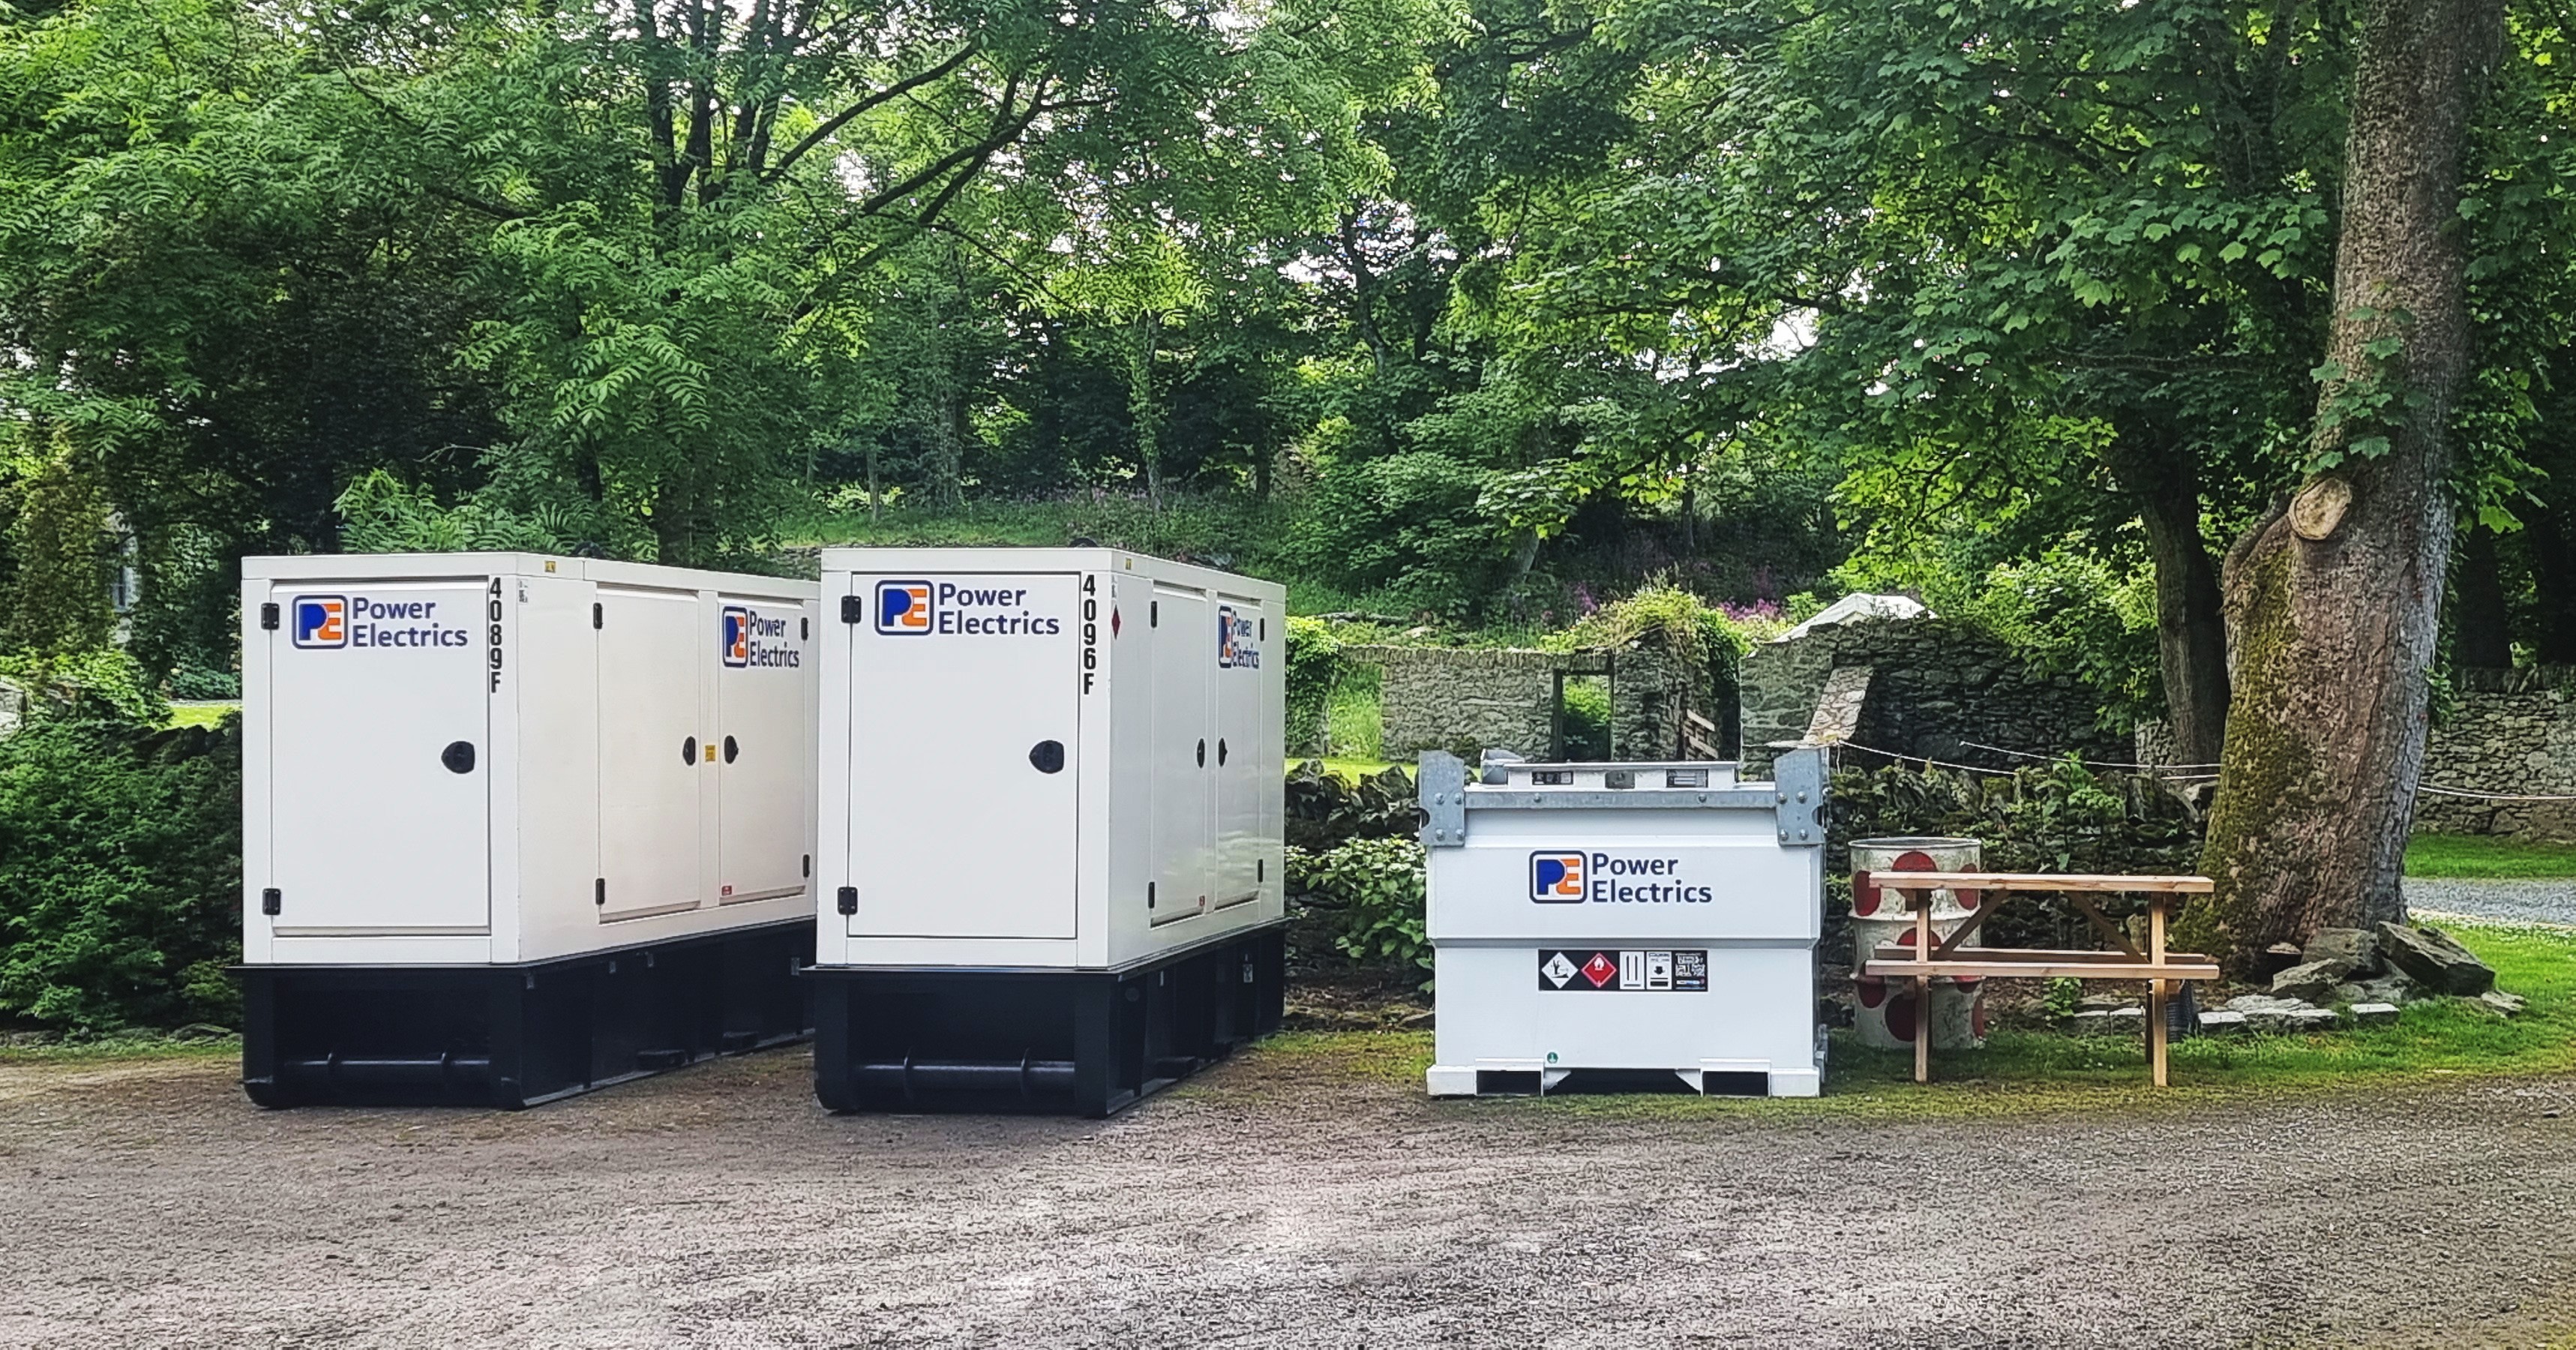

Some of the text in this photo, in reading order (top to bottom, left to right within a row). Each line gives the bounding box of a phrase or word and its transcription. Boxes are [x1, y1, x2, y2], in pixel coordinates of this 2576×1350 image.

[938, 583, 1027, 606] Power
[352, 597, 436, 620] Power
[352, 622, 468, 647] Electrics
[489, 577, 502, 693] 4089F
[749, 610, 786, 638] Power
[938, 610, 1060, 635] Electrics
[1083, 574, 1096, 695] 4096F
[749, 640, 799, 668] Electrics
[1592, 853, 1678, 875] Power
[1592, 878, 1713, 903] Electrics
